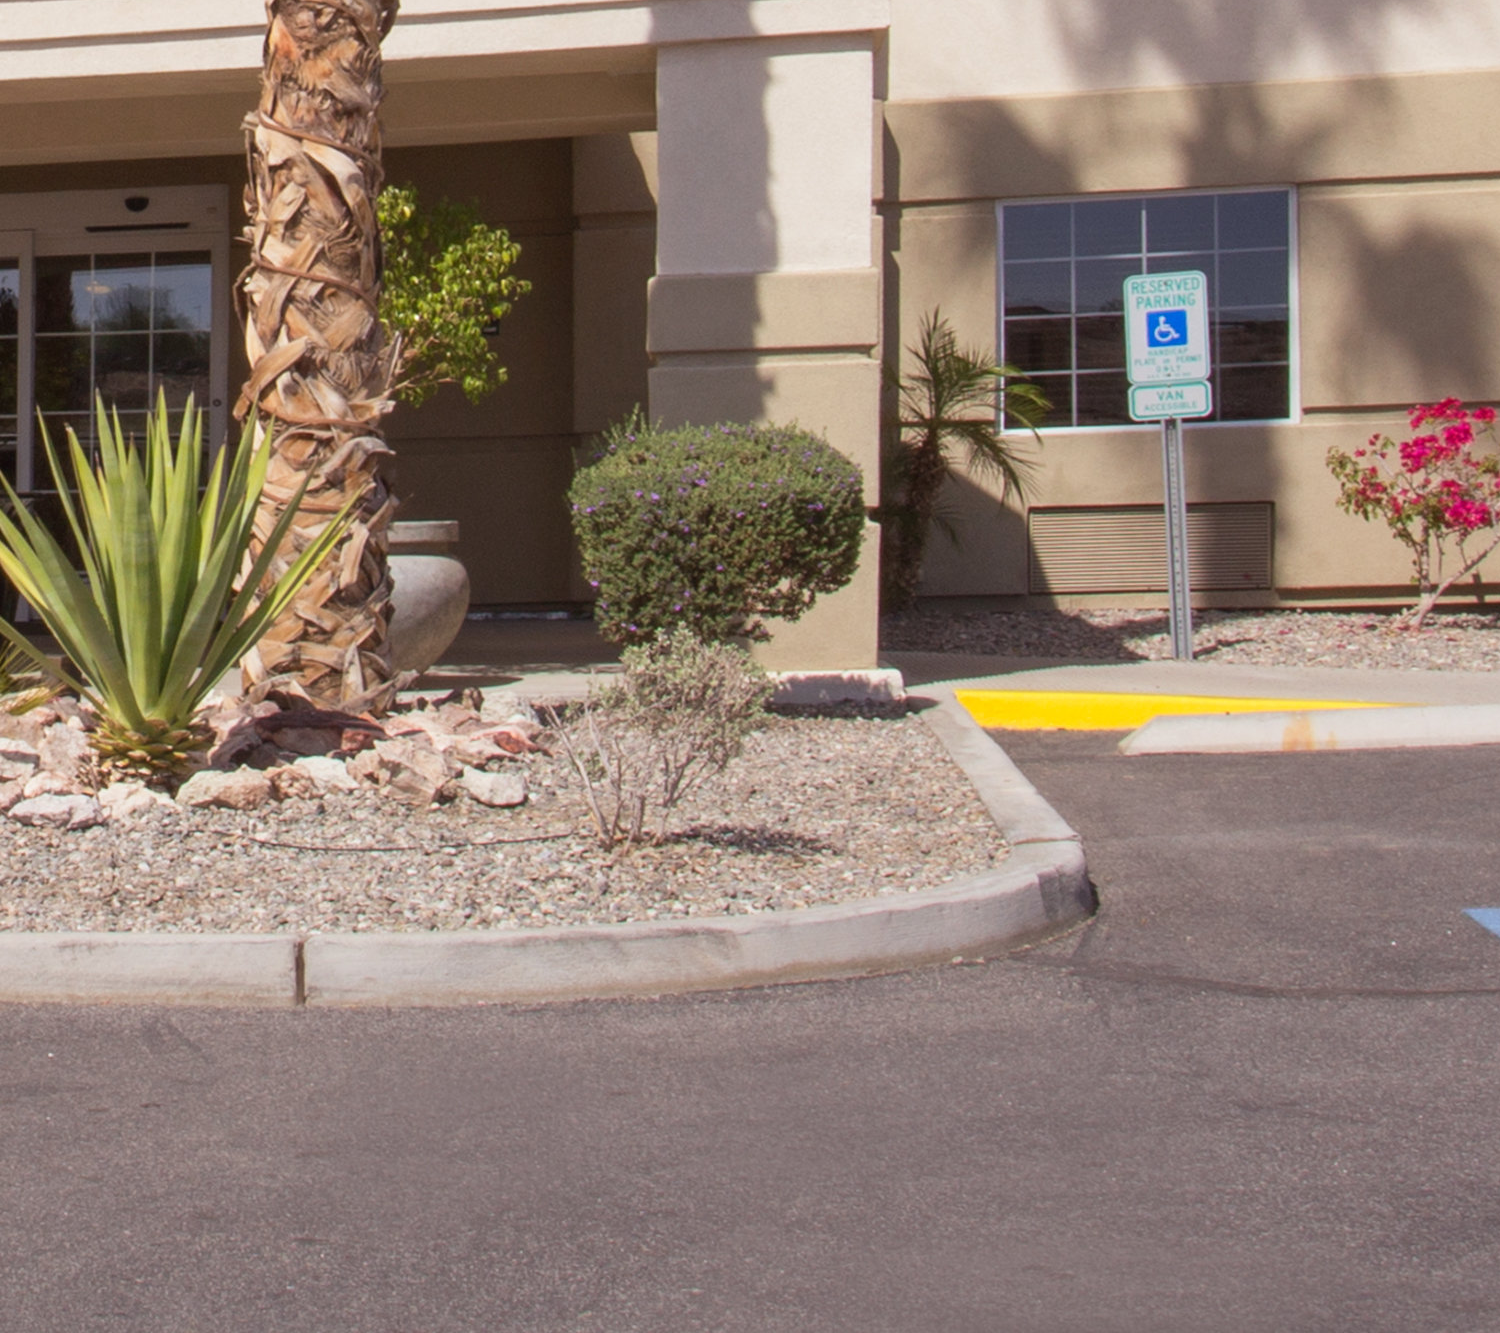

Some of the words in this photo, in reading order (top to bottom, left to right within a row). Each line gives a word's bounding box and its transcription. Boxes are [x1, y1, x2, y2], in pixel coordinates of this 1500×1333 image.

[1131, 278, 1200, 294] RESERVED
[1136, 293, 1196, 309] PARKING
[1157, 390, 1184, 401] VAN
[1144, 401, 1197, 412] ACCESSIBLE
